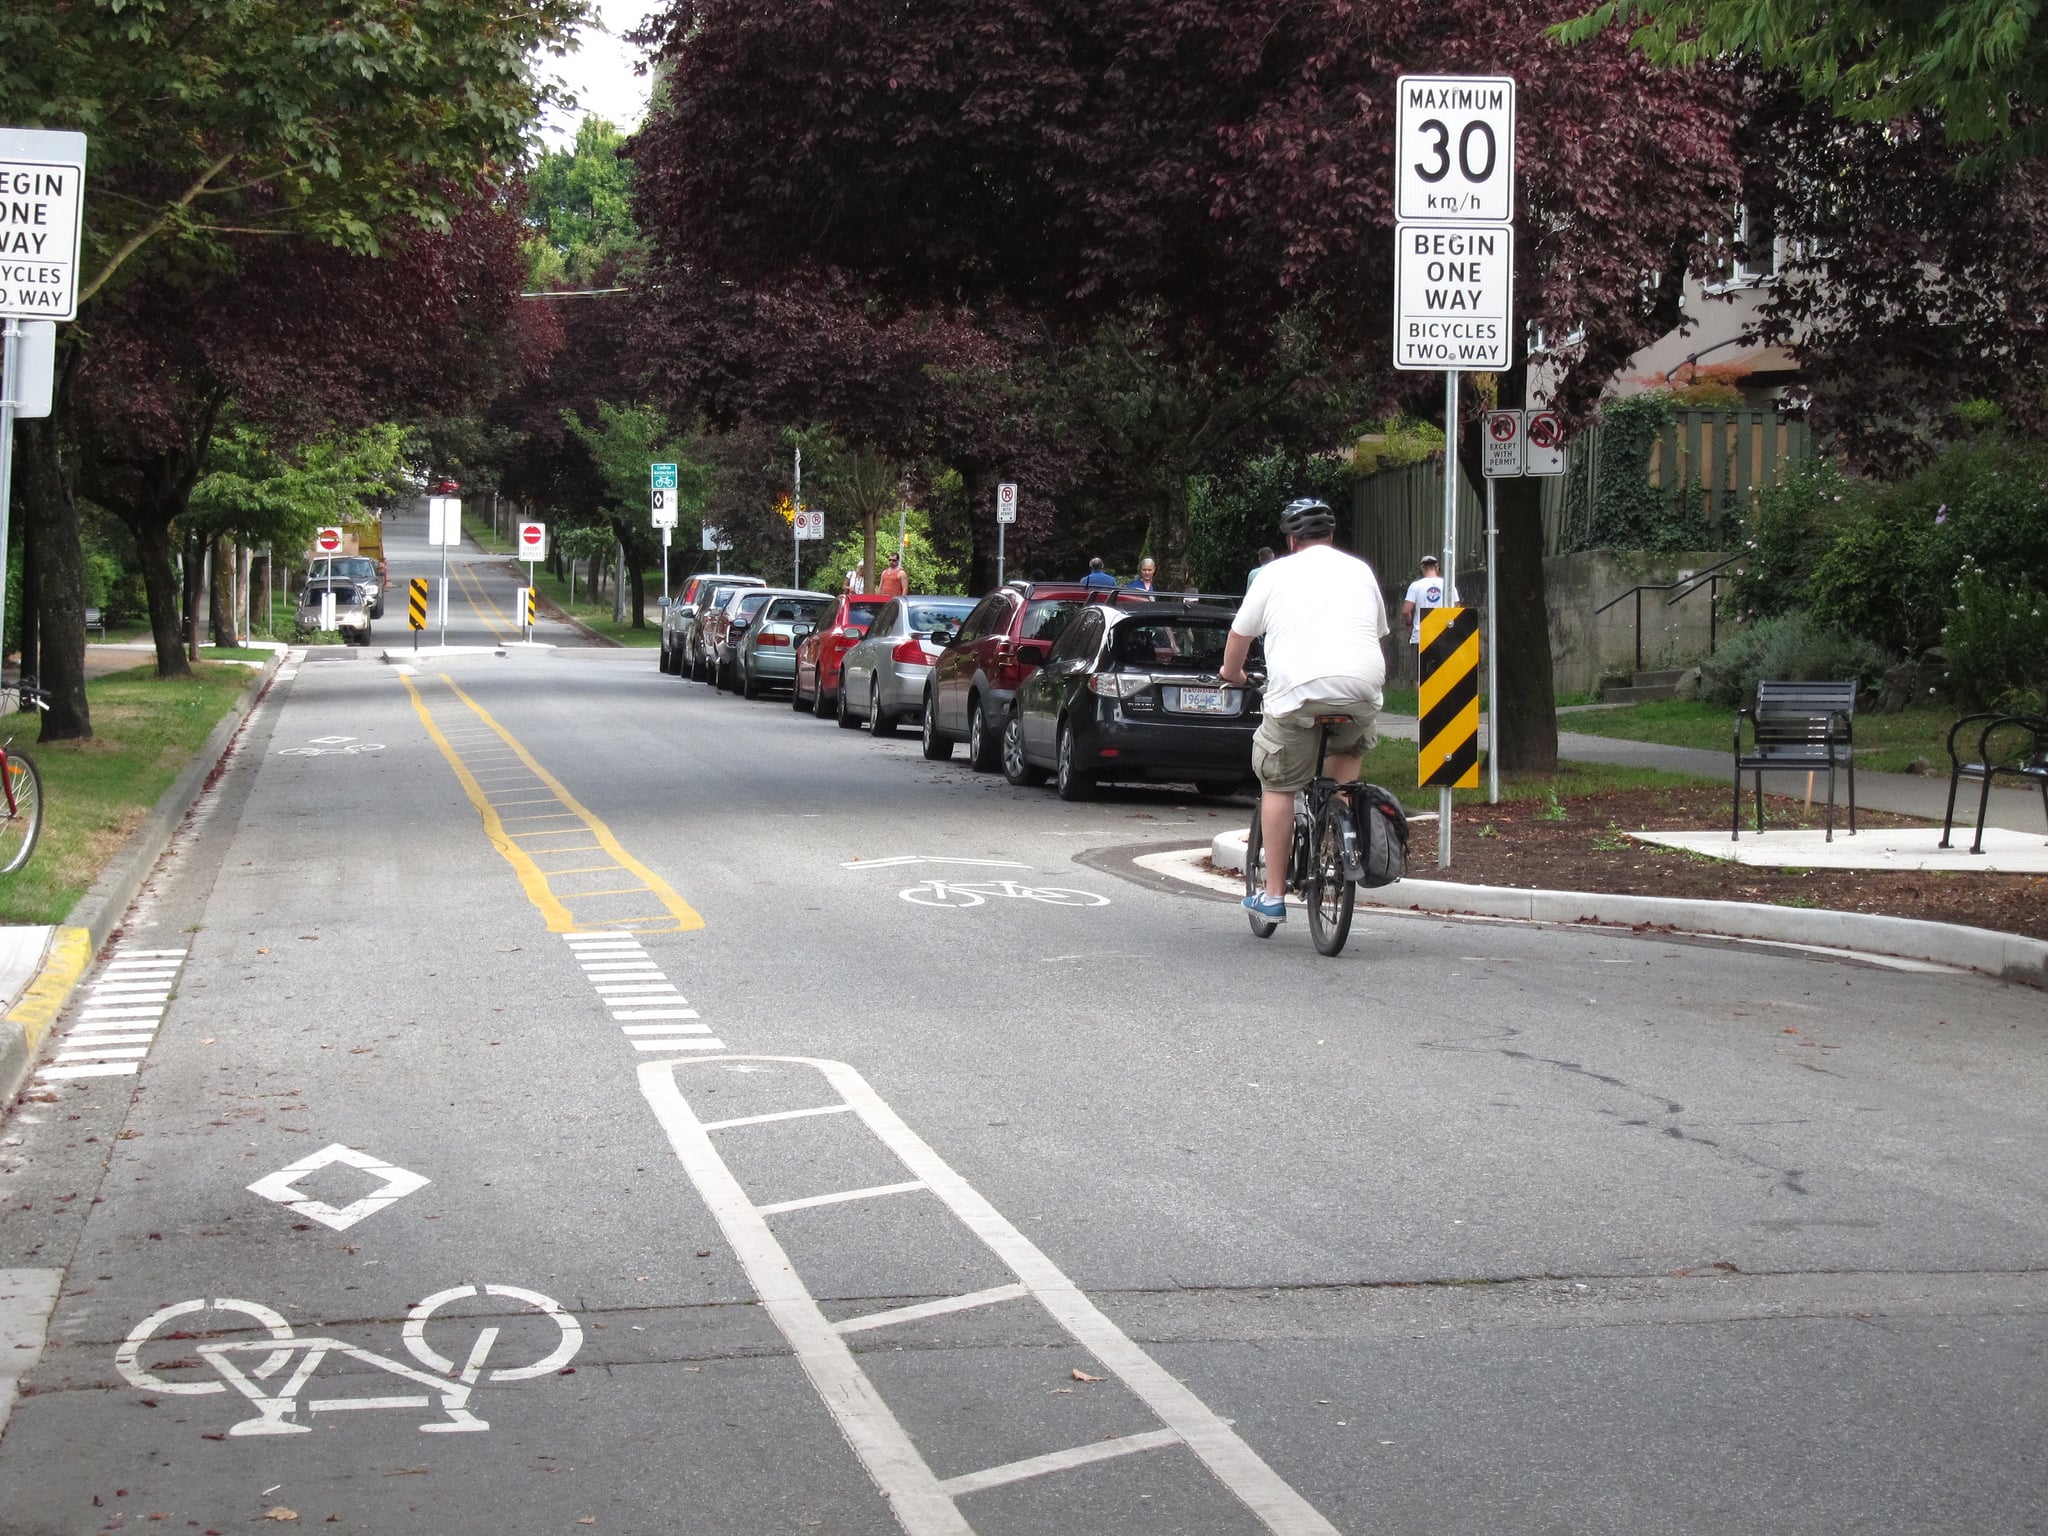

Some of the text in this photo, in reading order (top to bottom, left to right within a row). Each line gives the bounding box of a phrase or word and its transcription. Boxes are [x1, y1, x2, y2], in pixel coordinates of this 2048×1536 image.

[1410, 88, 1503, 110] MAXIMUM
[1414, 119, 1496, 184] 30
[0, 172, 63, 197] EGIN
[1428, 192, 1481, 211] km/h
[1415, 234, 1494, 256] BEGIN
[1, 265, 61, 284] YCLES
[1427, 261, 1482, 283] ONE
[19, 289, 63, 307] WAY
[1425, 289, 1482, 310] WAY
[1409, 323, 1496, 339] BICYCLES
[1406, 344, 1499, 360] TWO WAY
[1490, 458, 1517, 466] PERMIT
